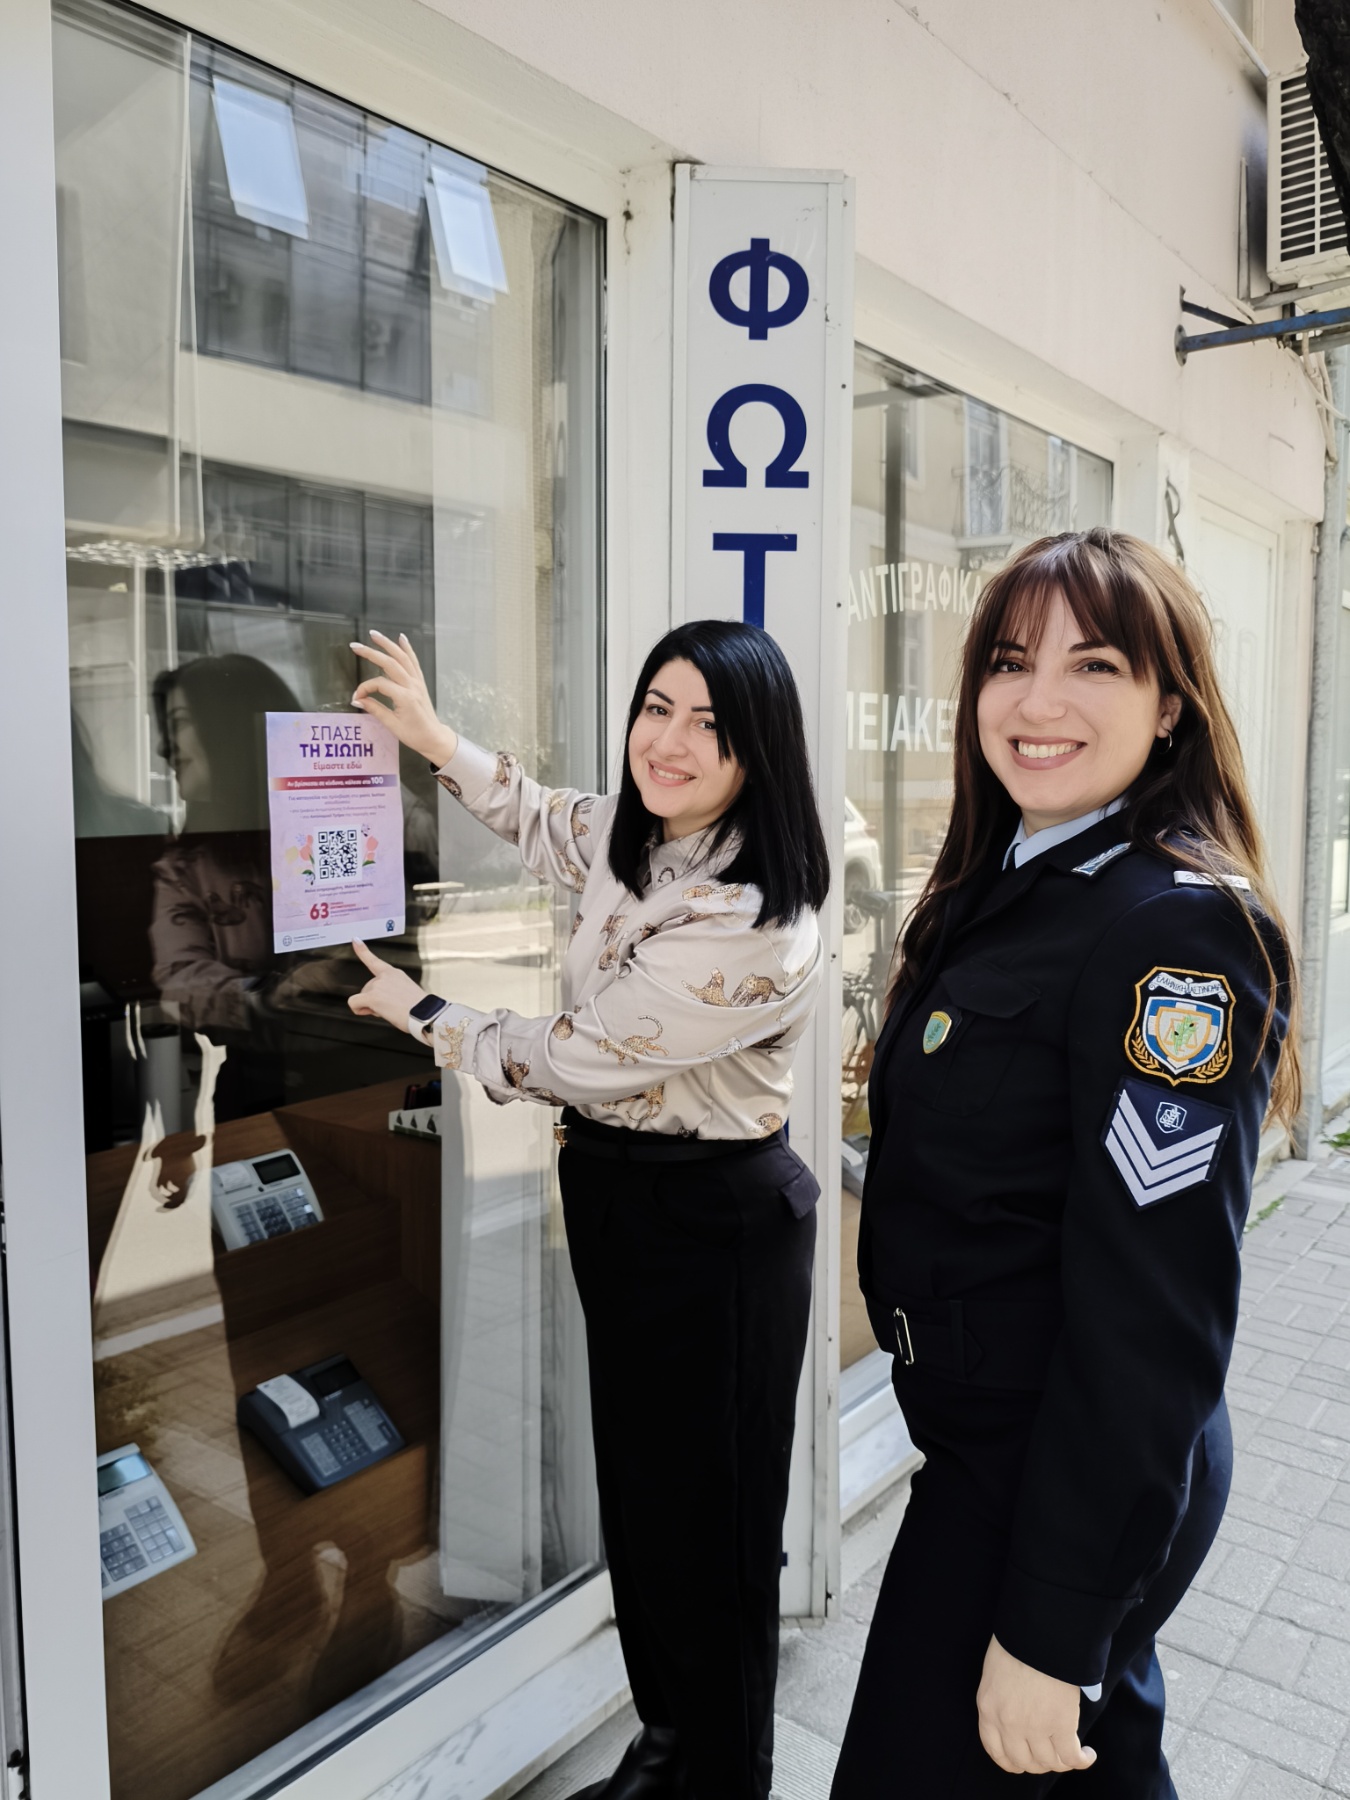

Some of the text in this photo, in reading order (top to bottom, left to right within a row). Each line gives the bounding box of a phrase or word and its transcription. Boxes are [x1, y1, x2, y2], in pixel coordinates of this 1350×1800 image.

[846, 691, 954, 752] ΕΙΑΚΕ
[311, 726, 362, 741] ΣΠΑΣΕ
[299, 743, 374, 758] ΤΗ ΣΙΩΠΗ
[313, 761, 363, 772] Είμαστε εδώ
[371, 776, 384, 785] 100
[310, 902, 329, 920] 63
